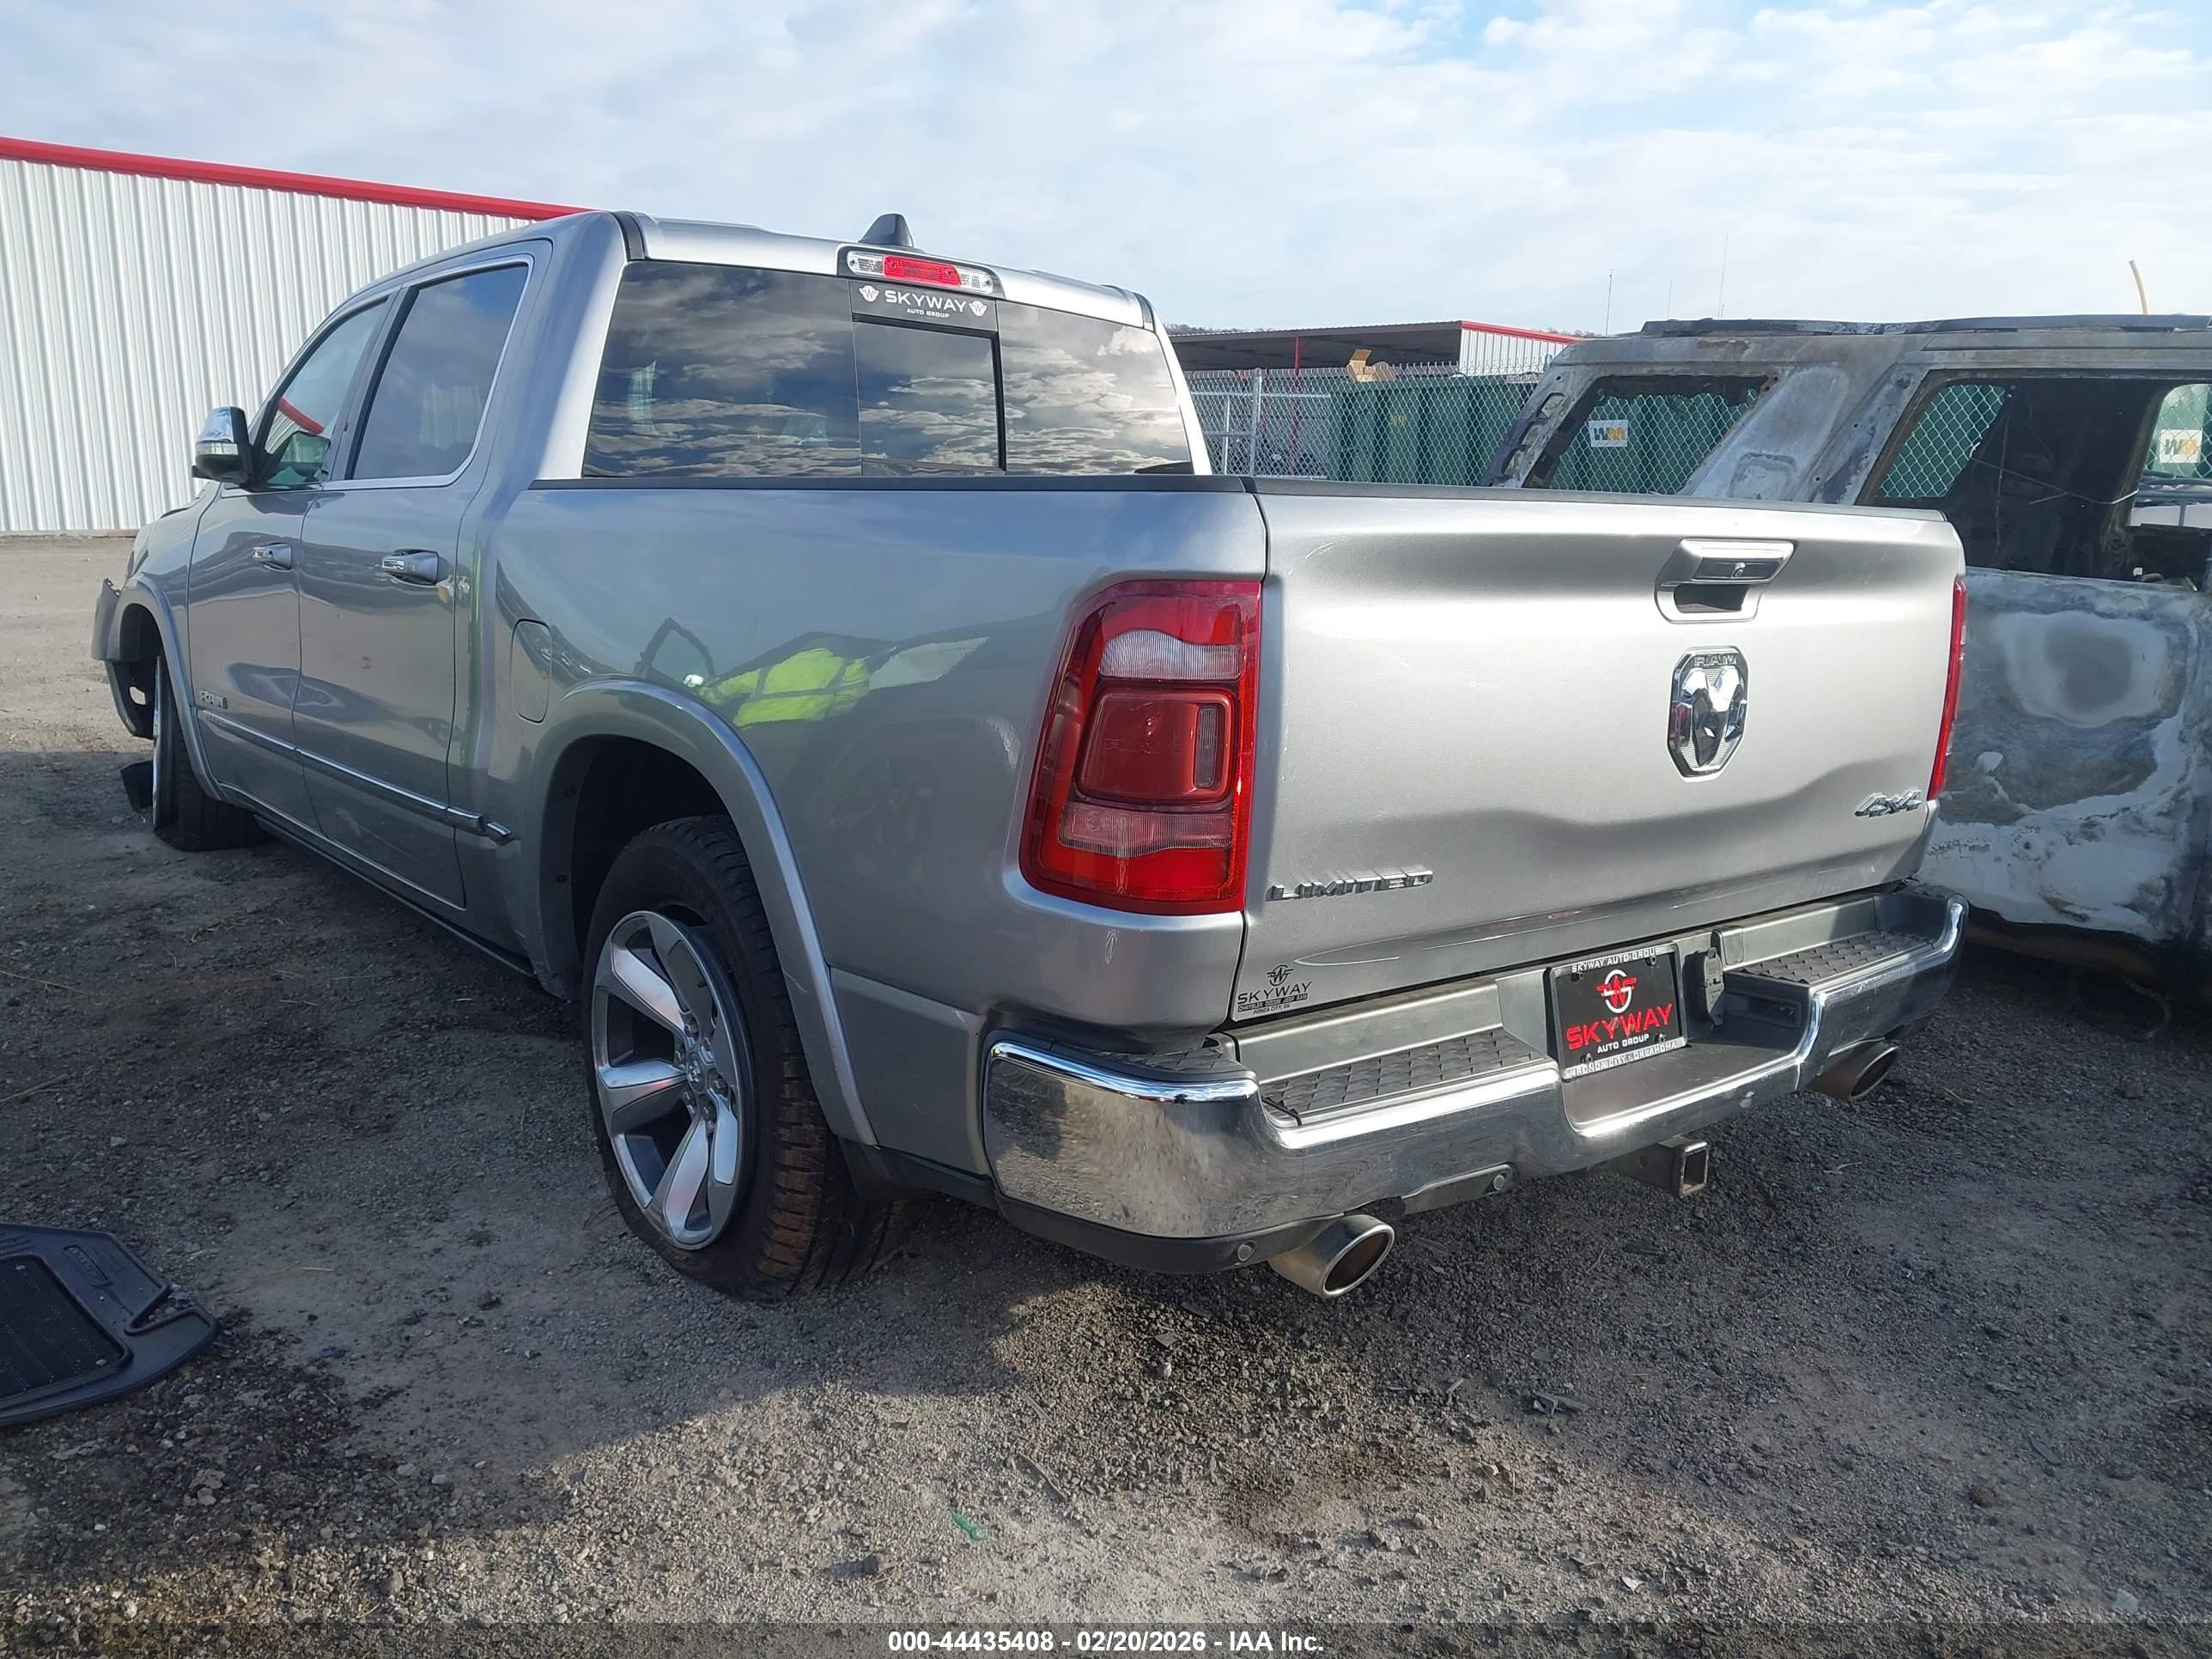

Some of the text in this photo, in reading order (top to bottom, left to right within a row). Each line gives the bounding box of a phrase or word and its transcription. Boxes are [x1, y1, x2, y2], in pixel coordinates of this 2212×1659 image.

[884, 290, 966, 312] SKYWAY
[926, 310, 950, 319] GROUP
[1693, 653, 1737, 667] RAM
[1266, 870, 1433, 902] LIMITED
[1571, 947, 1660, 973] SKYWAY AUTO GROUP
[1237, 981, 1312, 1005] SKYWAY
[1566, 1003, 1673, 1050] SKYWAY
[1597, 1033, 1650, 1054] AUTO GROUP
